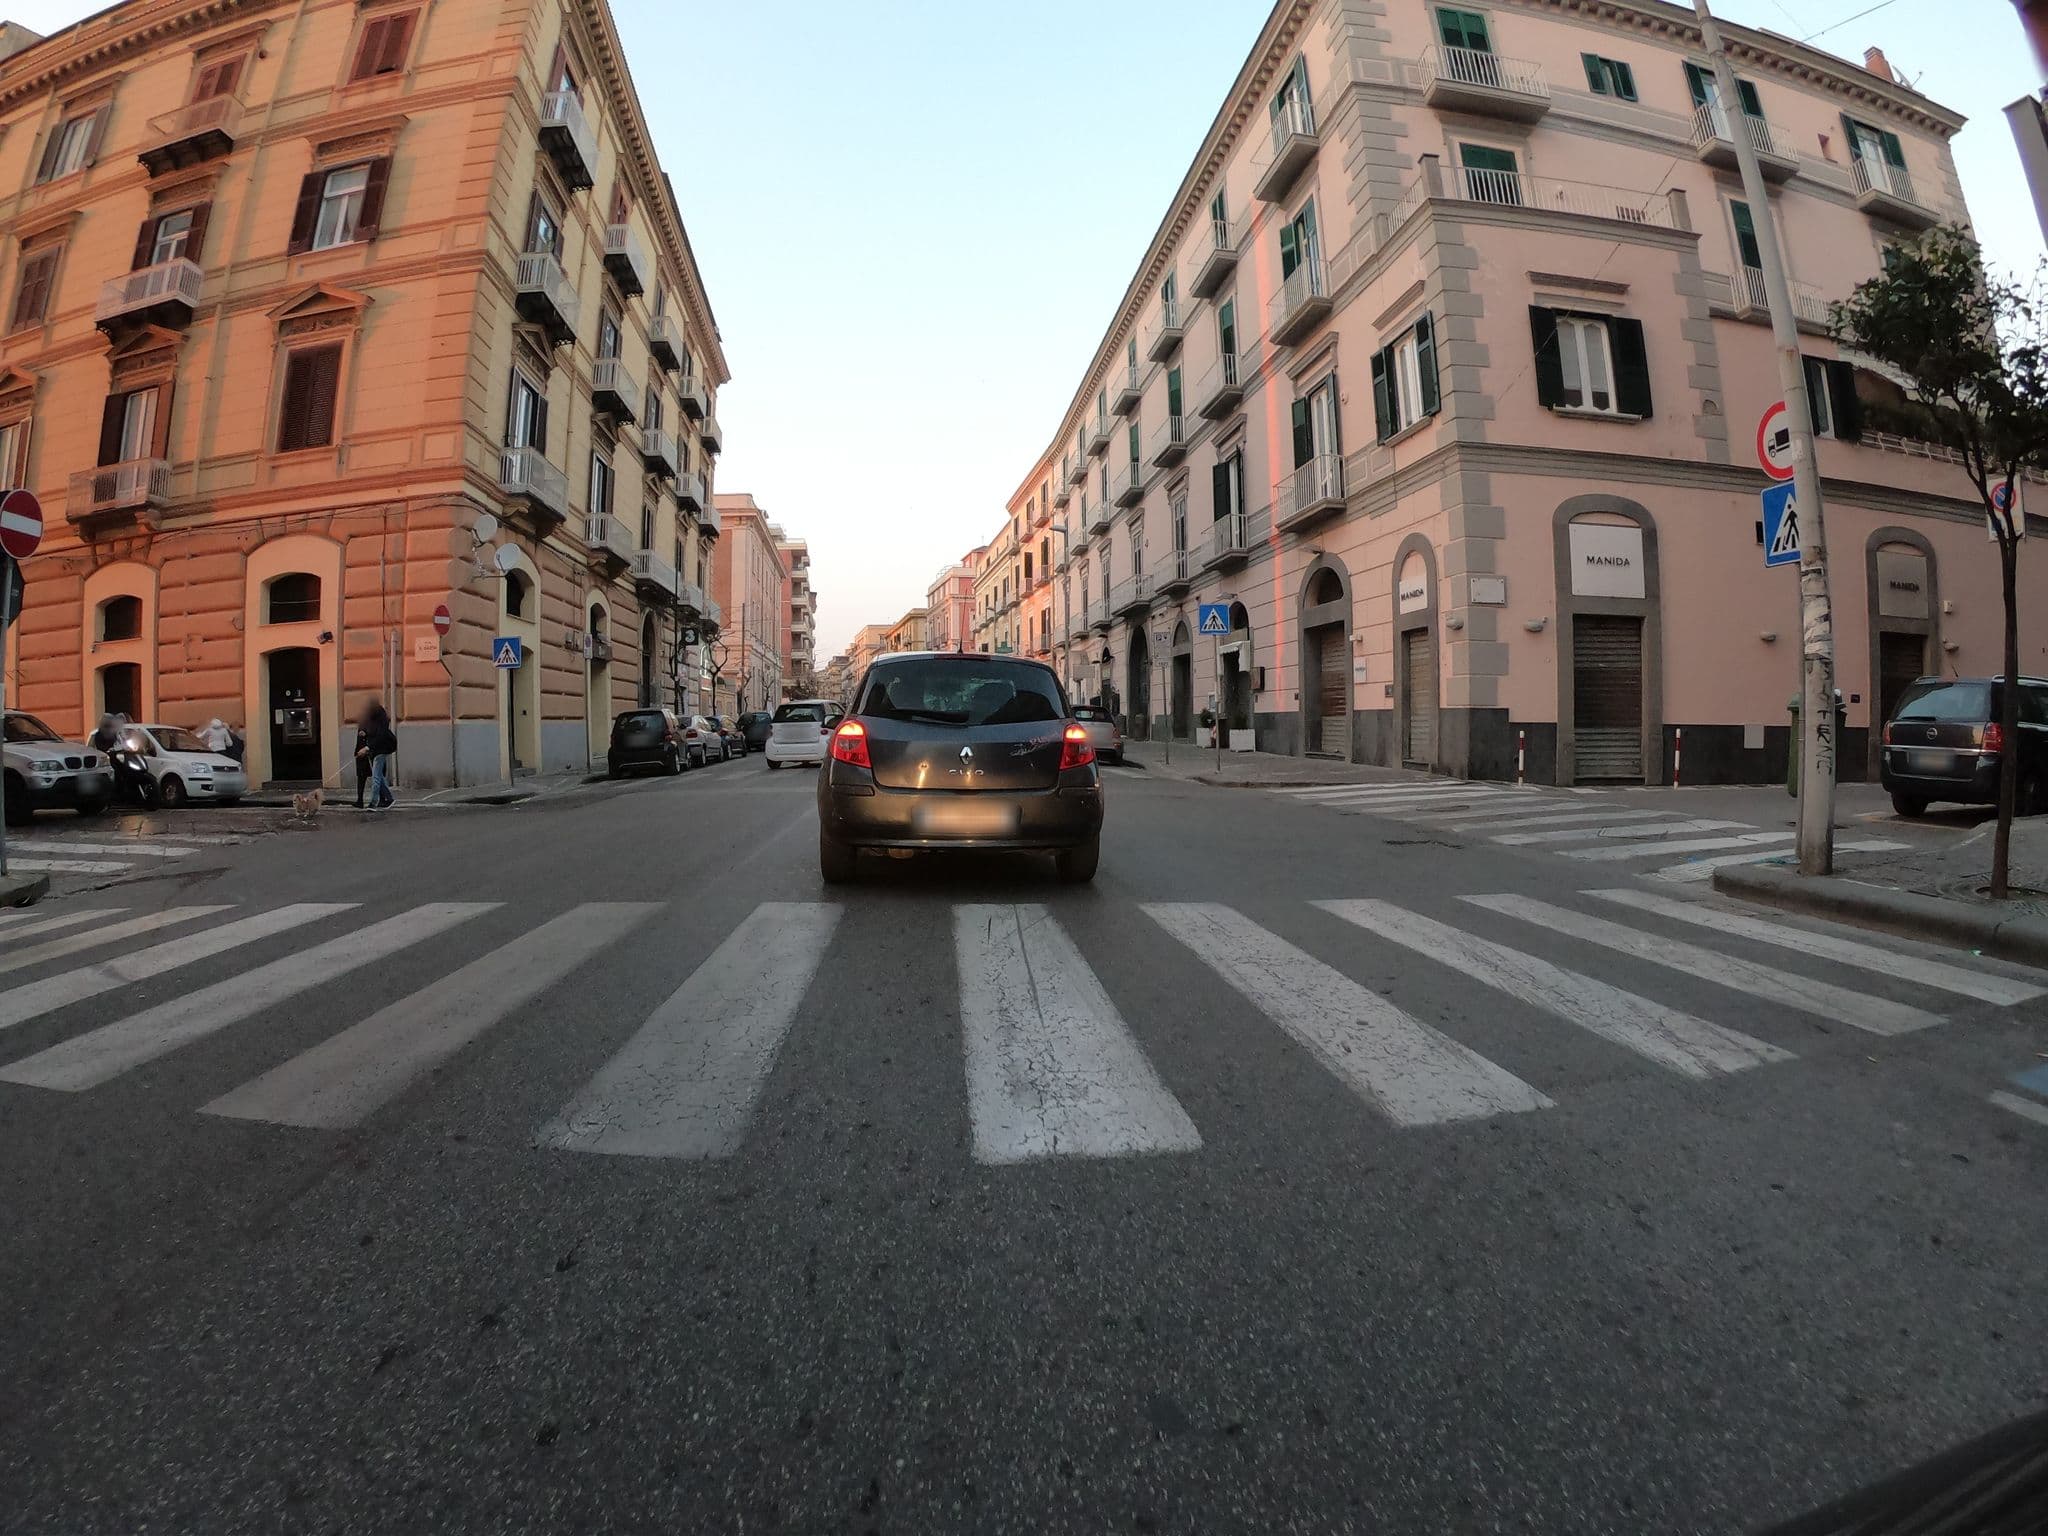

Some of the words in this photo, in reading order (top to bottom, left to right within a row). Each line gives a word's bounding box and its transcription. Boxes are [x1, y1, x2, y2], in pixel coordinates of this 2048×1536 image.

[1586, 555, 1631, 567] MANIDA
[1401, 588, 1424, 601] MANIDA
[685, 629, 696, 643] 3
